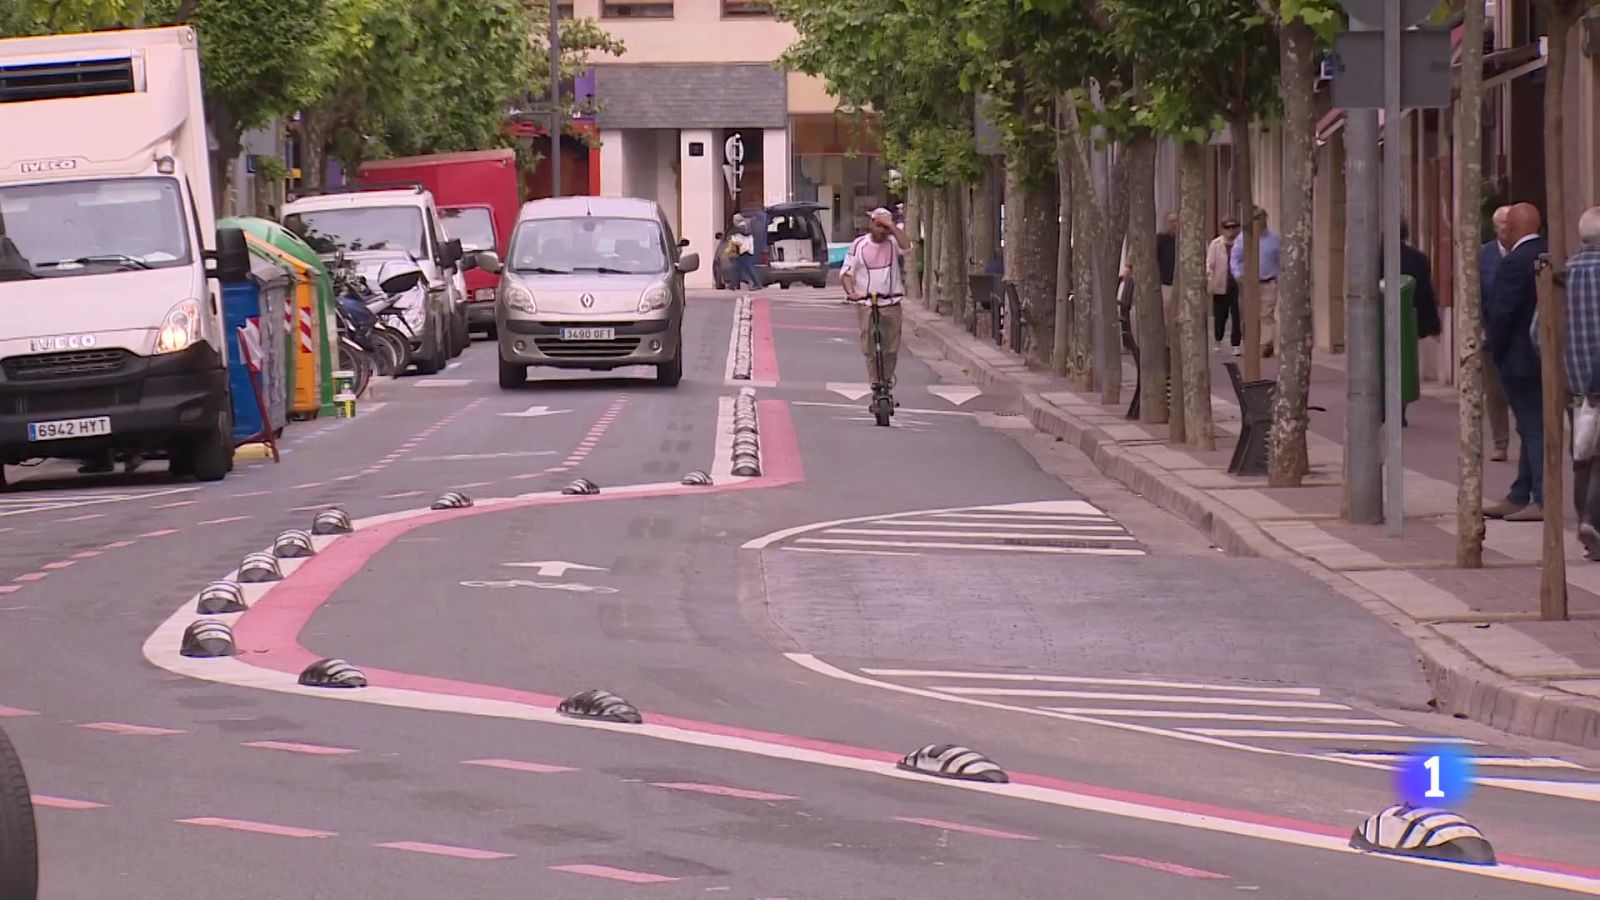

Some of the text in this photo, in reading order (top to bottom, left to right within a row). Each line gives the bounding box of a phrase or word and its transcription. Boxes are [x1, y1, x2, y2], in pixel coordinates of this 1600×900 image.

[30, 334, 97, 352] IVECO
[38, 419, 107, 437] 6942 HYT
